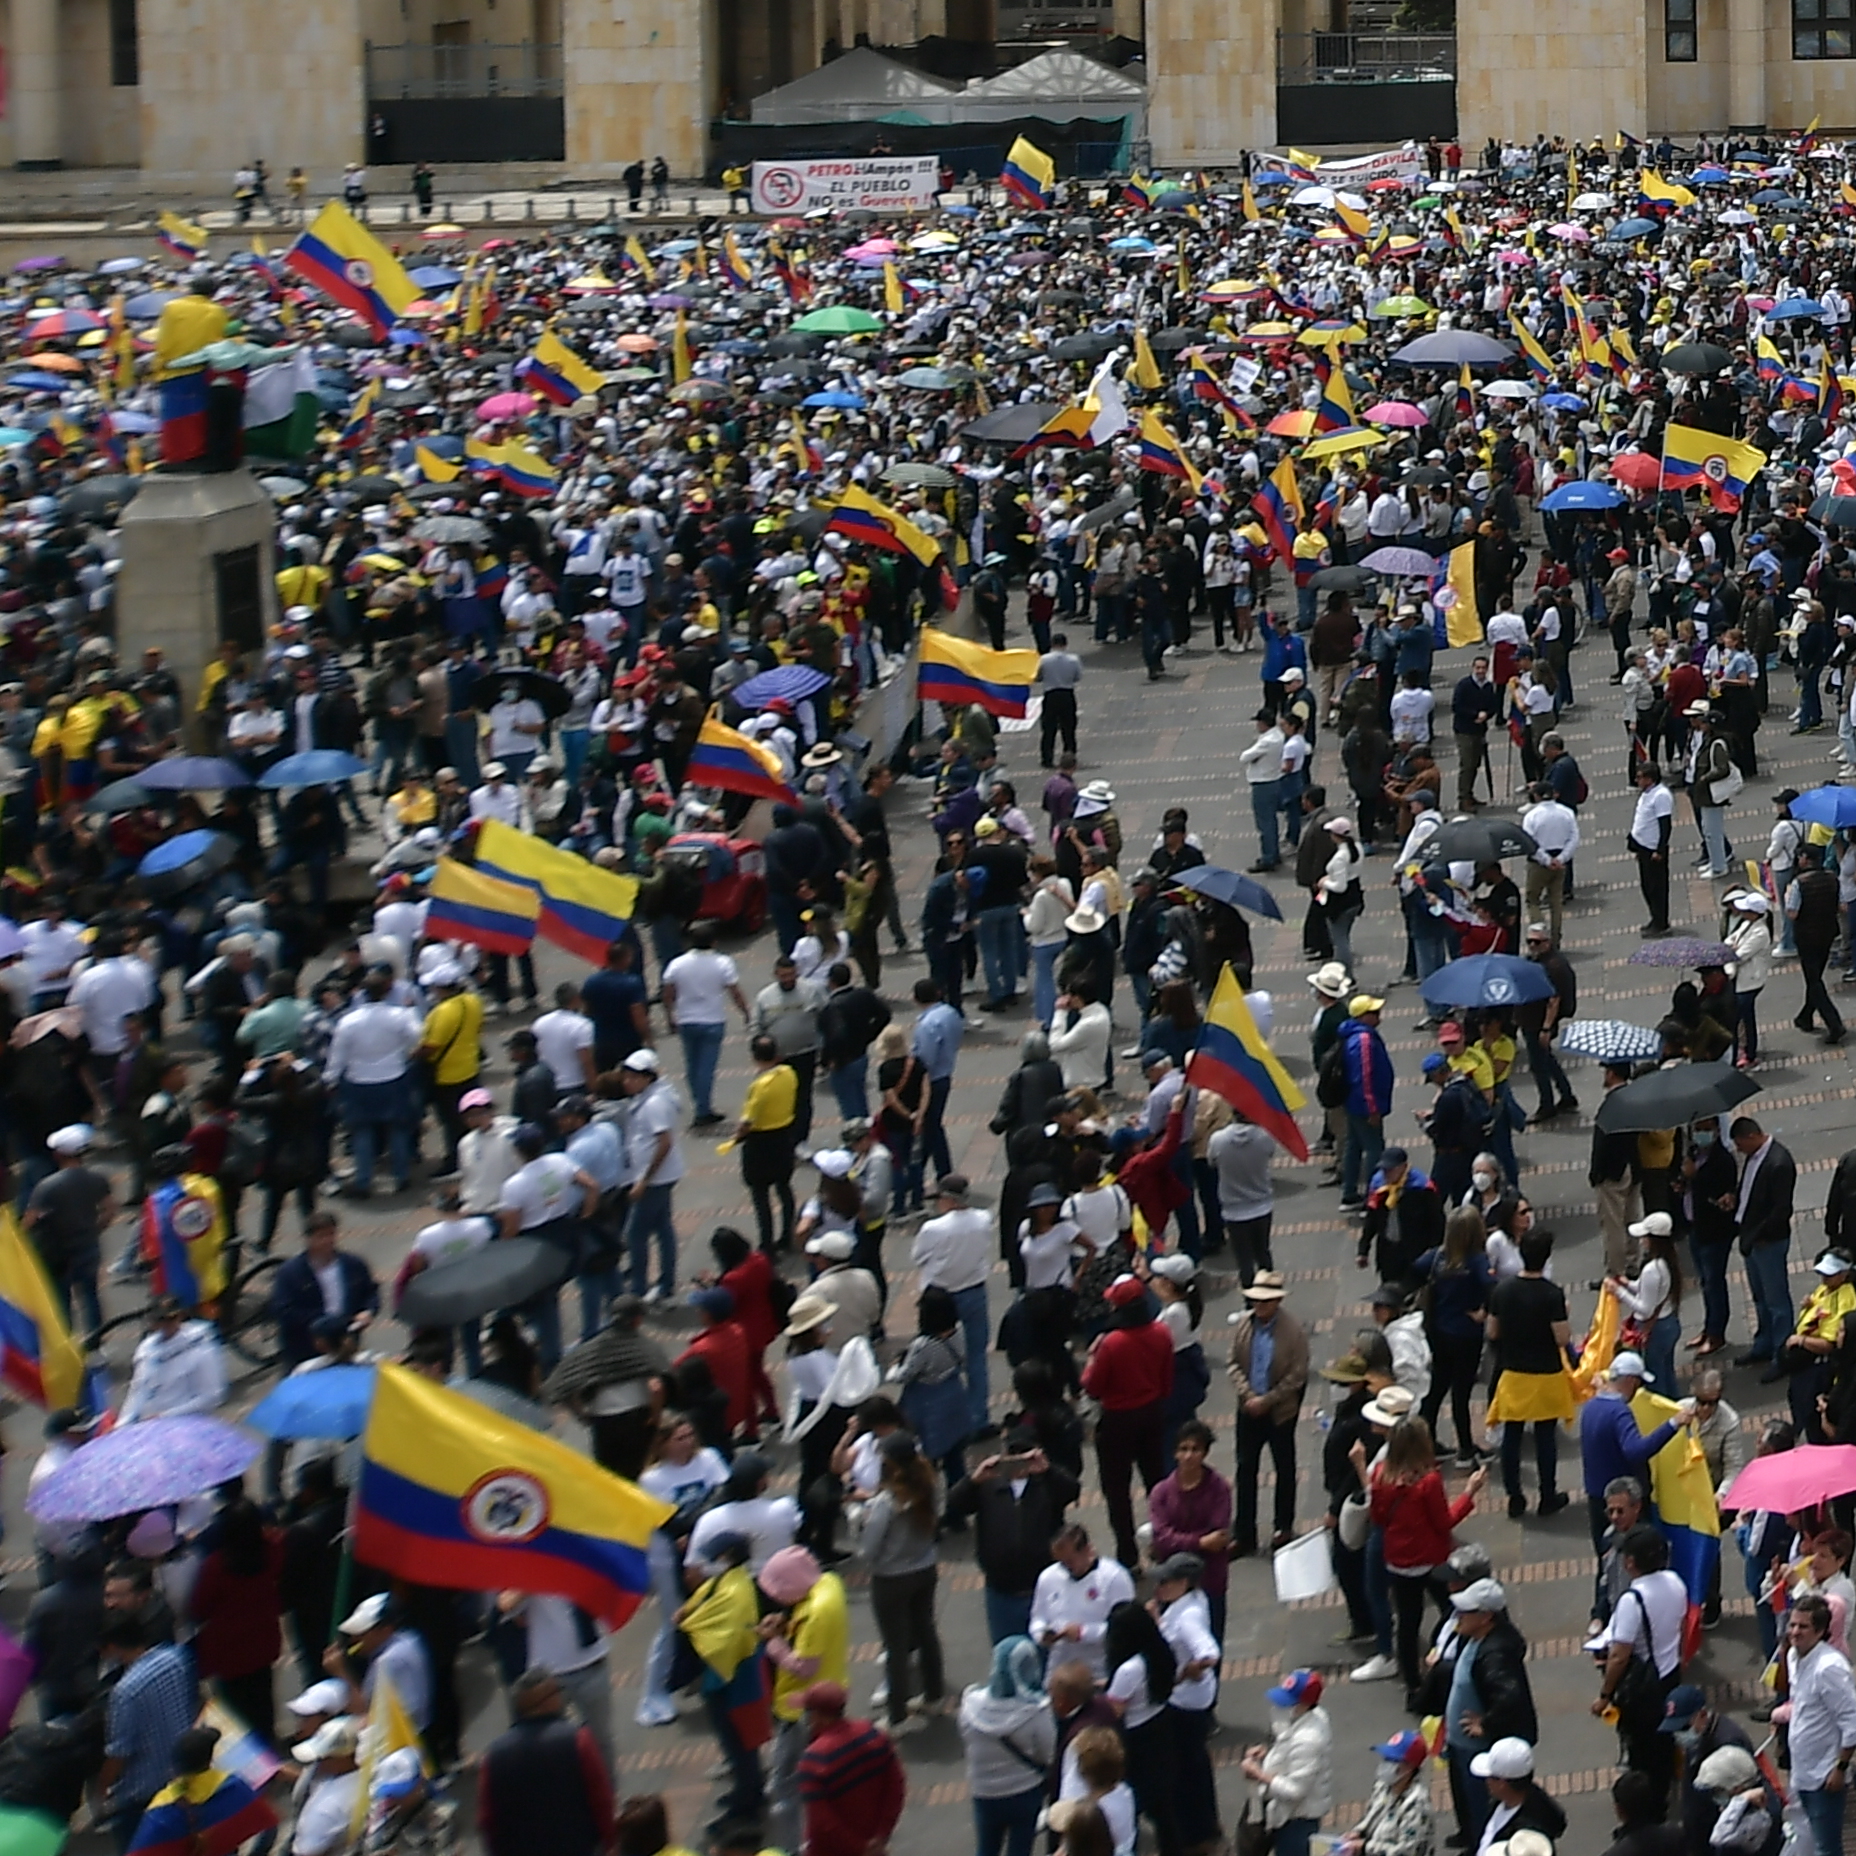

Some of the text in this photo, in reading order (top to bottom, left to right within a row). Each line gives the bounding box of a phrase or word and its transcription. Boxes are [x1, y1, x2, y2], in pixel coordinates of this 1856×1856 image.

[808, 164, 852, 177] PETRO
[830, 179, 911, 193] EL PUEBLO
[808, 196, 832, 207] NO
[838, 197, 855, 207] es
